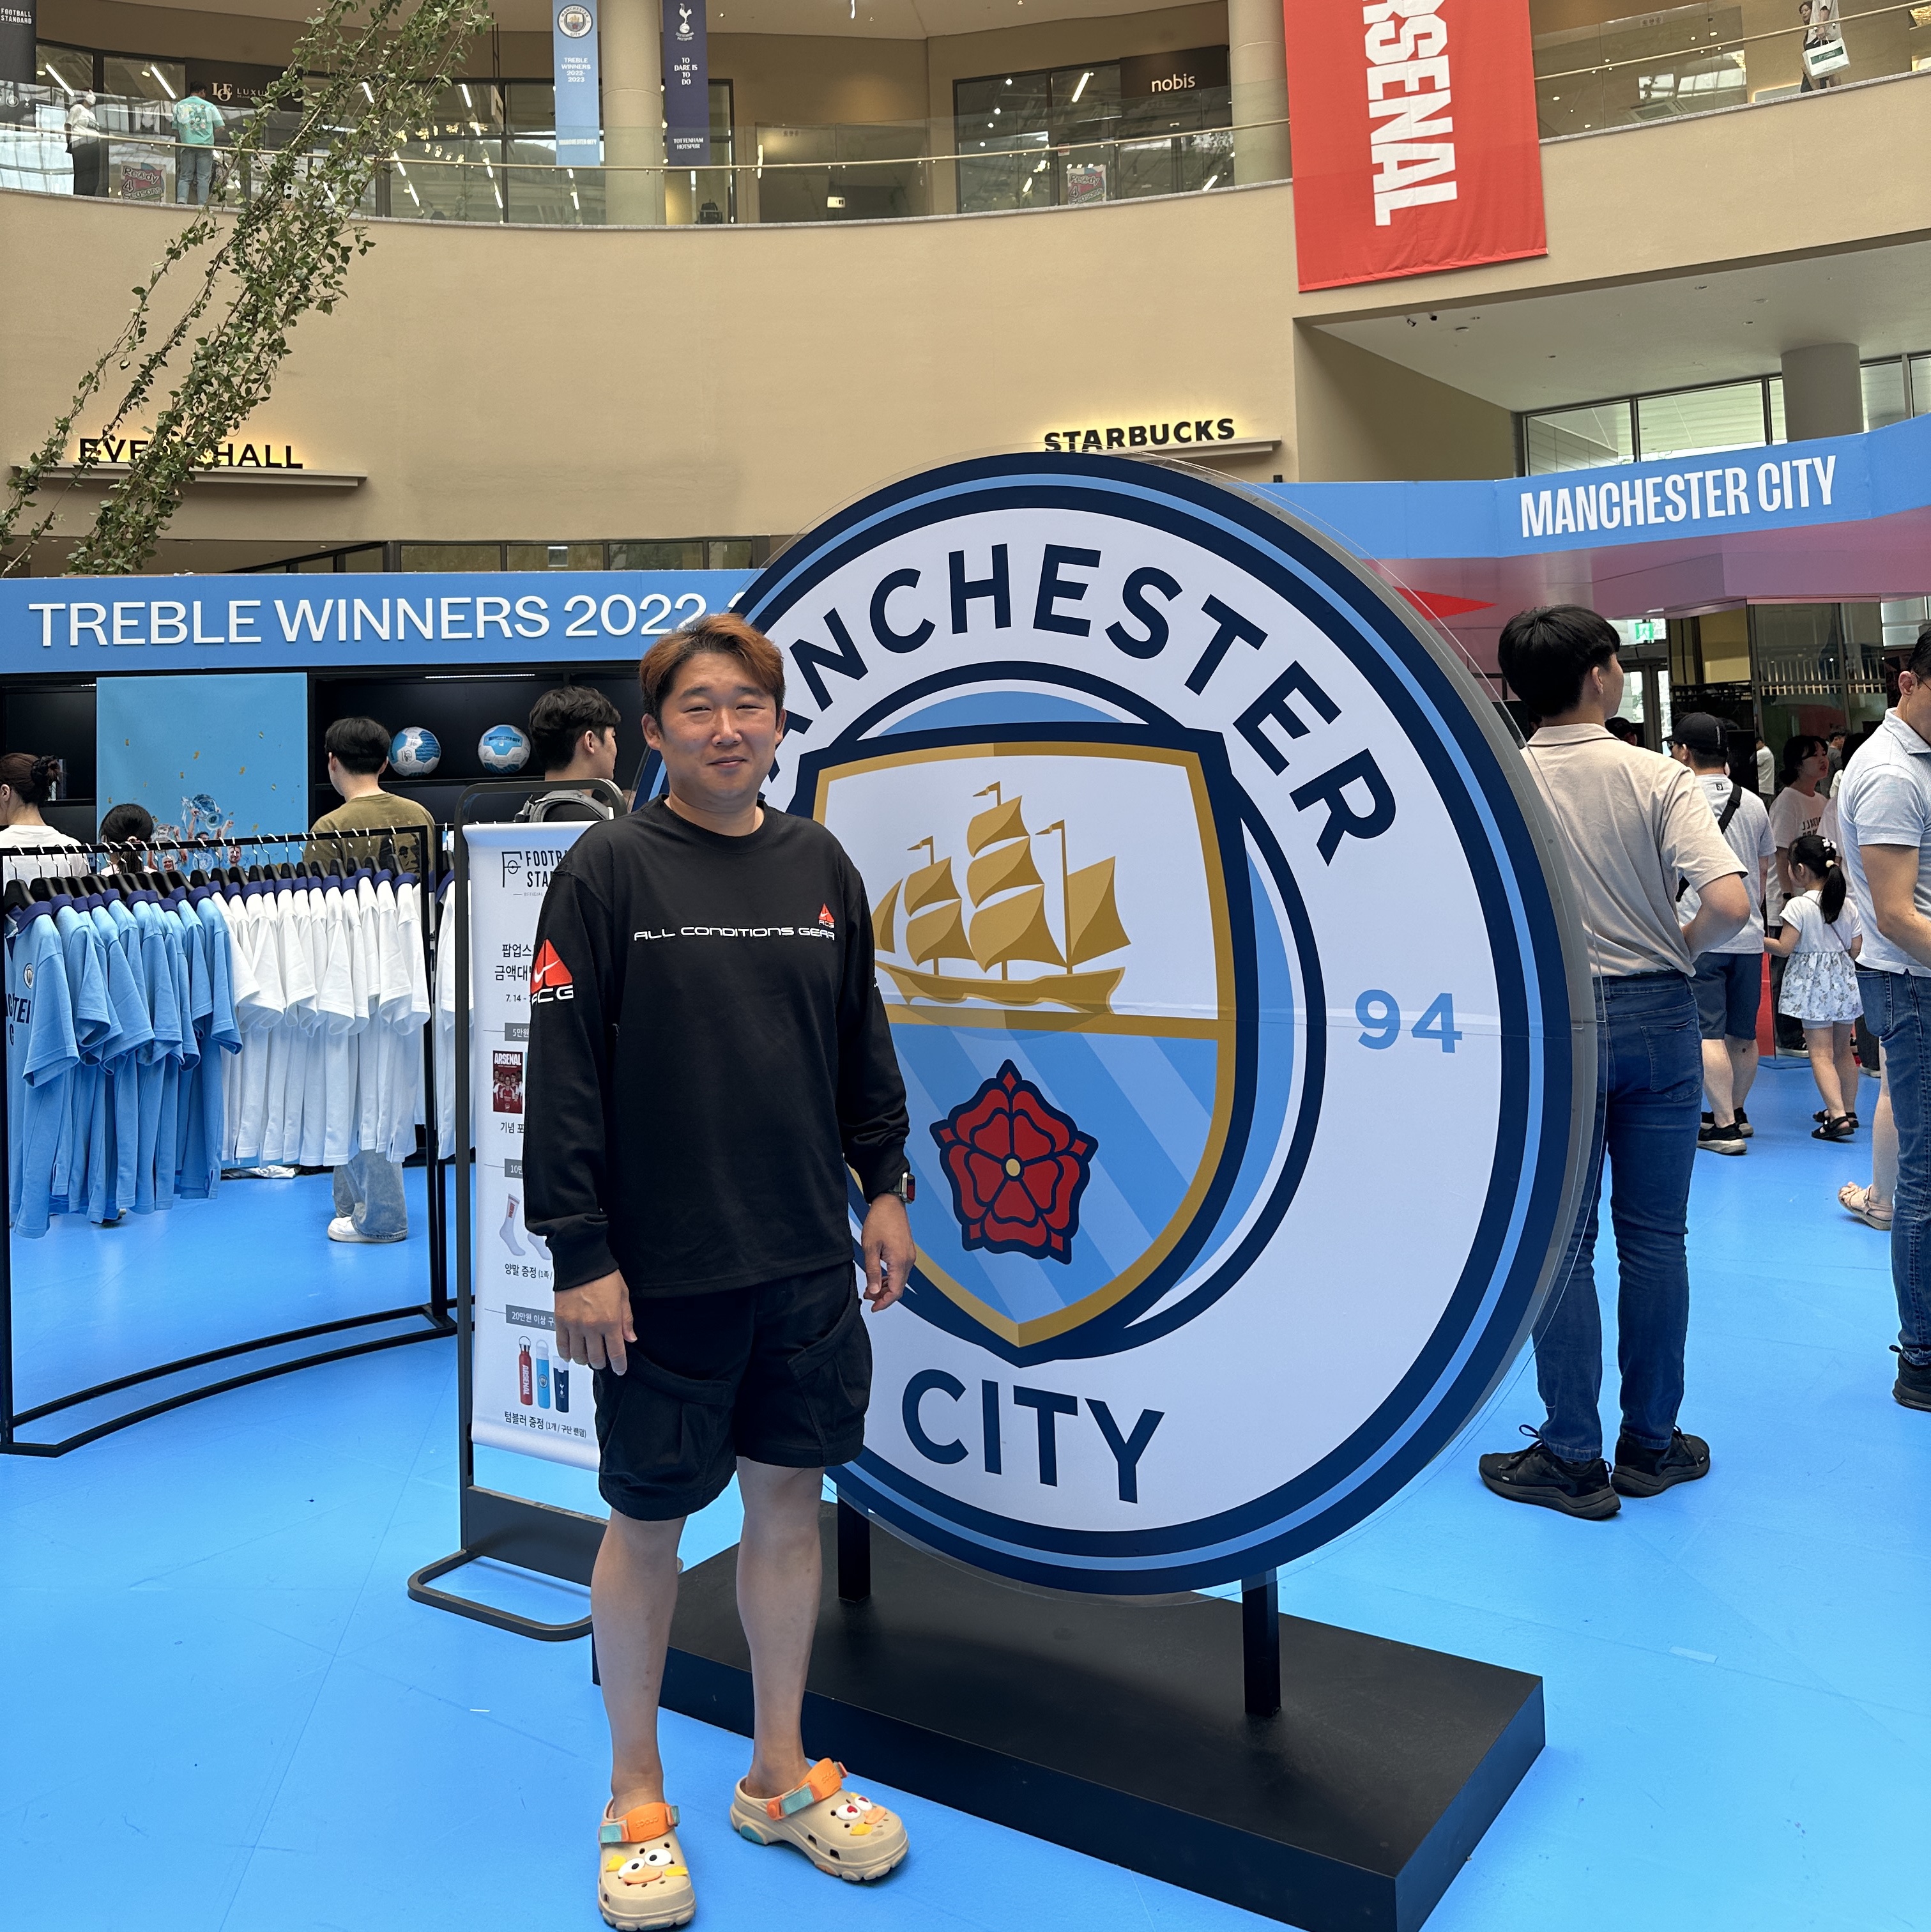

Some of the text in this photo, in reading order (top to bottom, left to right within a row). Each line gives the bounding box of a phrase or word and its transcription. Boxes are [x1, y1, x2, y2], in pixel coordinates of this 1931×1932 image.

[1, 8, 31, 17] FOOTBALL
[1, 15, 32, 24] STANDARD
[1151, 73, 1196, 93] nobis
[123, 178, 134, 192] 4
[1070, 185, 1079, 198] 4
[1044, 418, 1235, 452] STARBUCKS
[217, 443, 303, 470] HALL
[1520, 454, 1836, 539] MANCHESTER CITY
[28, 592, 707, 648] TREBLE WINNERS 2022
[760, 543, 1396, 866] NCHESTER
[525, 850, 566, 867] FOOTB
[526, 871, 552, 887] STA
[634, 926, 835, 941] ALL CONDITIONS GEAR
[502, 943, 533, 958] 팝업스
[494, 965, 531, 981] 금액대
[1355, 989, 1463, 1054] 94
[494, 1052, 522, 1066] ARSENAL
[500, 1121, 515, 1134] 기념
[505, 1263, 519, 1276] 양말
[521, 1265, 537, 1279] 증정
[512, 1311, 532, 1323] 20만원
[533, 1314, 546, 1326] 이상
[504, 1411, 527, 1427] 텀블러
[529, 1416, 544, 1430] 증정
[902, 1368, 1165, 1505] CITY
